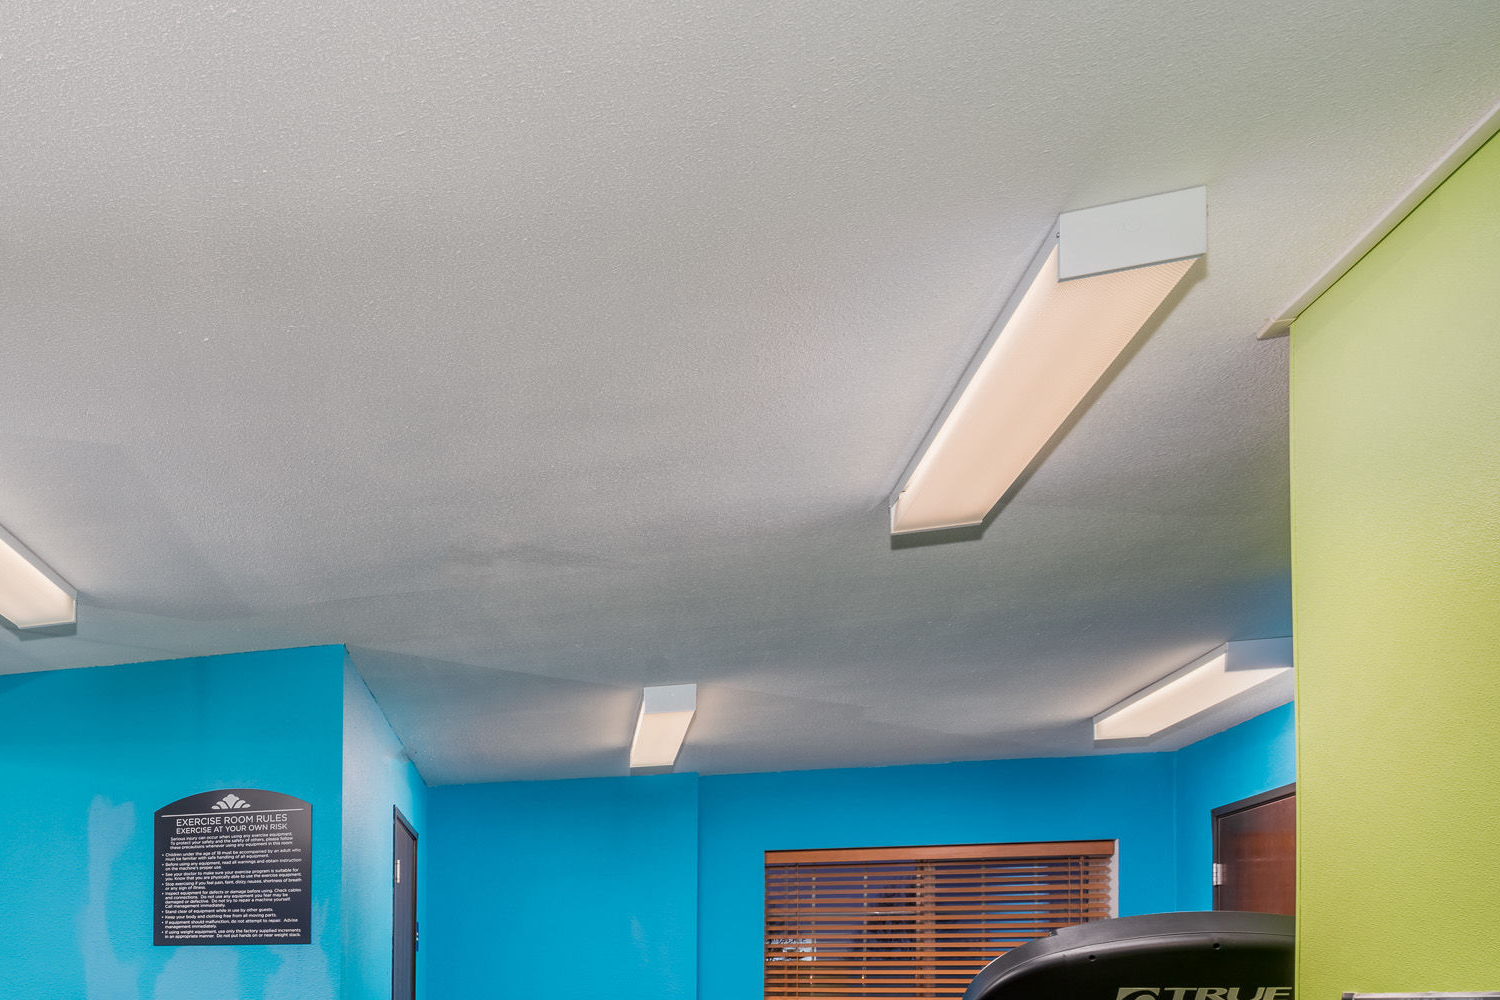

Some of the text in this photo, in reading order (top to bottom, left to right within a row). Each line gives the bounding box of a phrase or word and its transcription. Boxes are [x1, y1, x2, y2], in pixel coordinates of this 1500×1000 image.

[175, 813, 287, 826] EXERCISE ROOM RULES
[175, 826, 211, 834] EXERCISE
